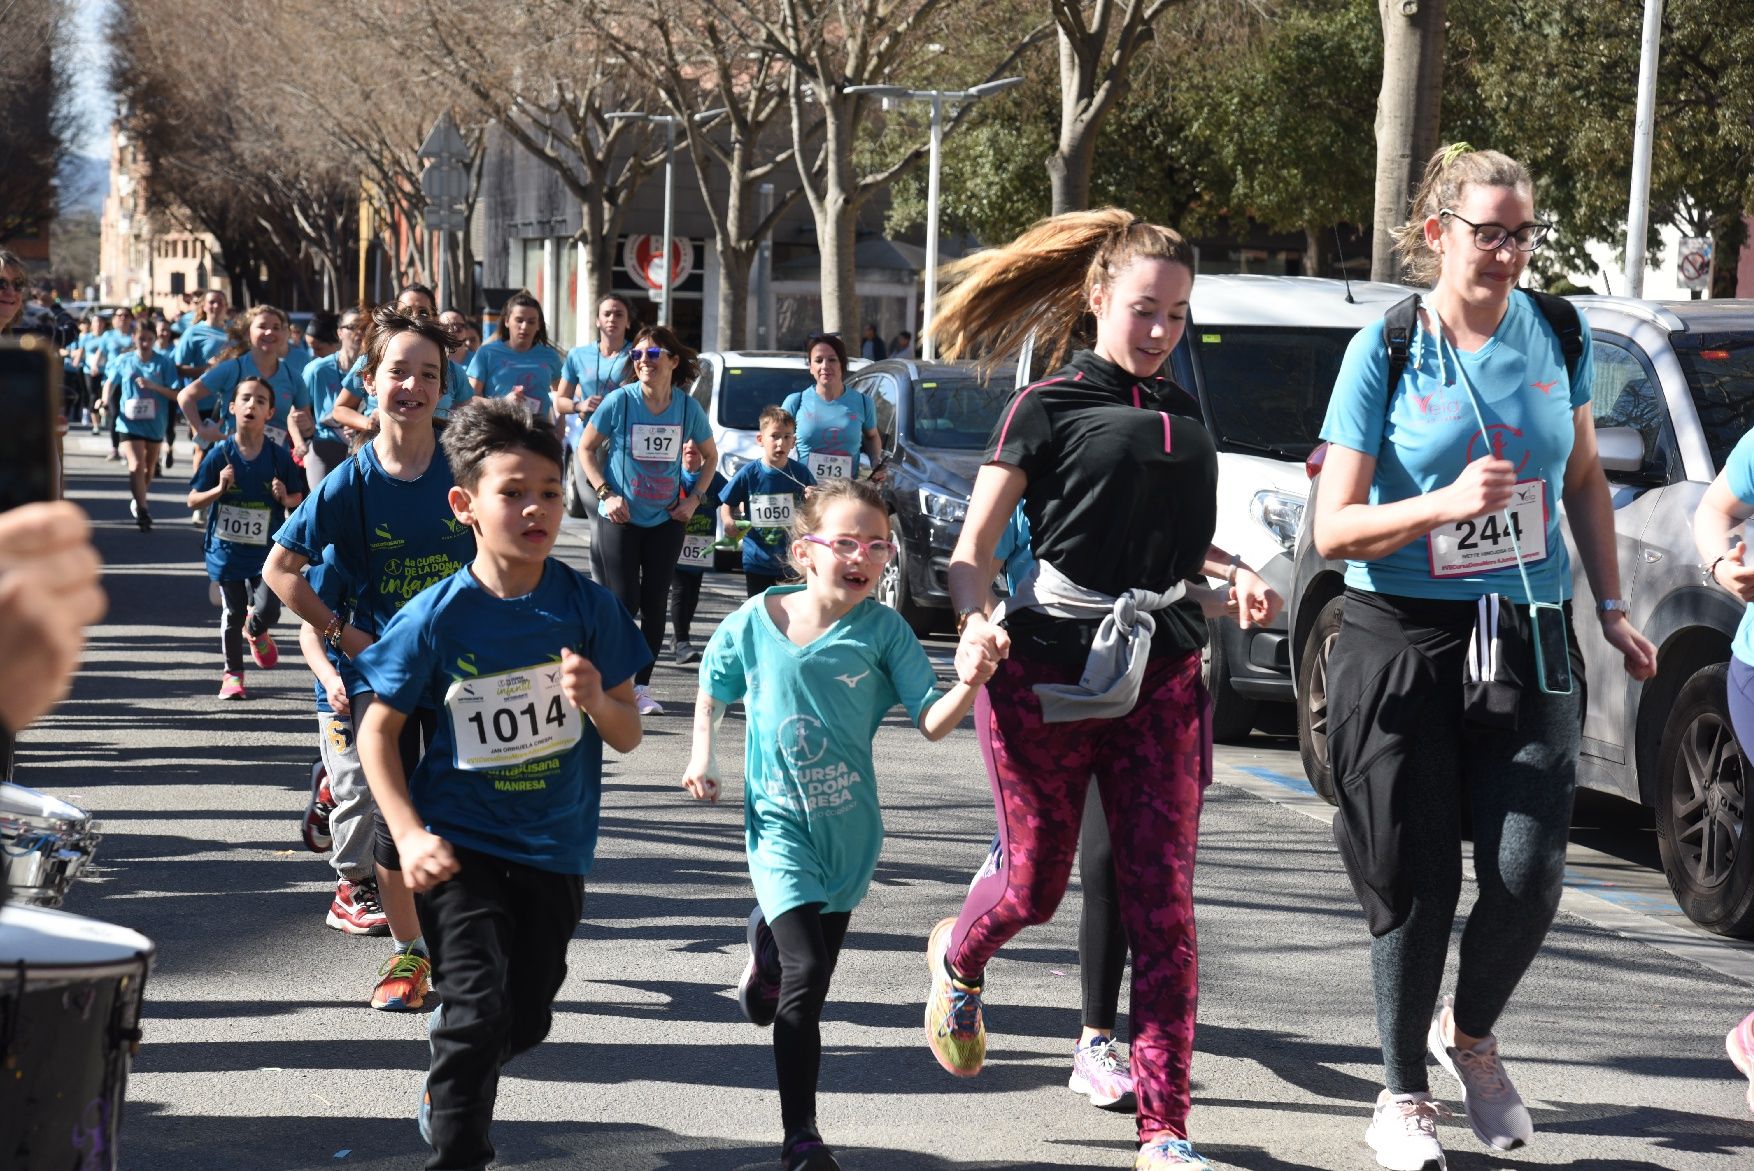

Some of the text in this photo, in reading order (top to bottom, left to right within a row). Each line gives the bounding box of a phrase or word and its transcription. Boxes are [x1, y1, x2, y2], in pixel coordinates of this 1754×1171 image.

[644, 437, 672, 451] 197
[816, 464, 842, 477] 513
[756, 506, 790, 519] 1050
[223, 518, 262, 535] 1013
[1455, 511, 1523, 550] 244
[417, 553, 448, 567] CURSA
[405, 567, 418, 576] DE
[419, 565, 430, 575] LA
[468, 694, 566, 744] 1014
[495, 779, 546, 791] MANRESA
[808, 771, 861, 795] DONA
